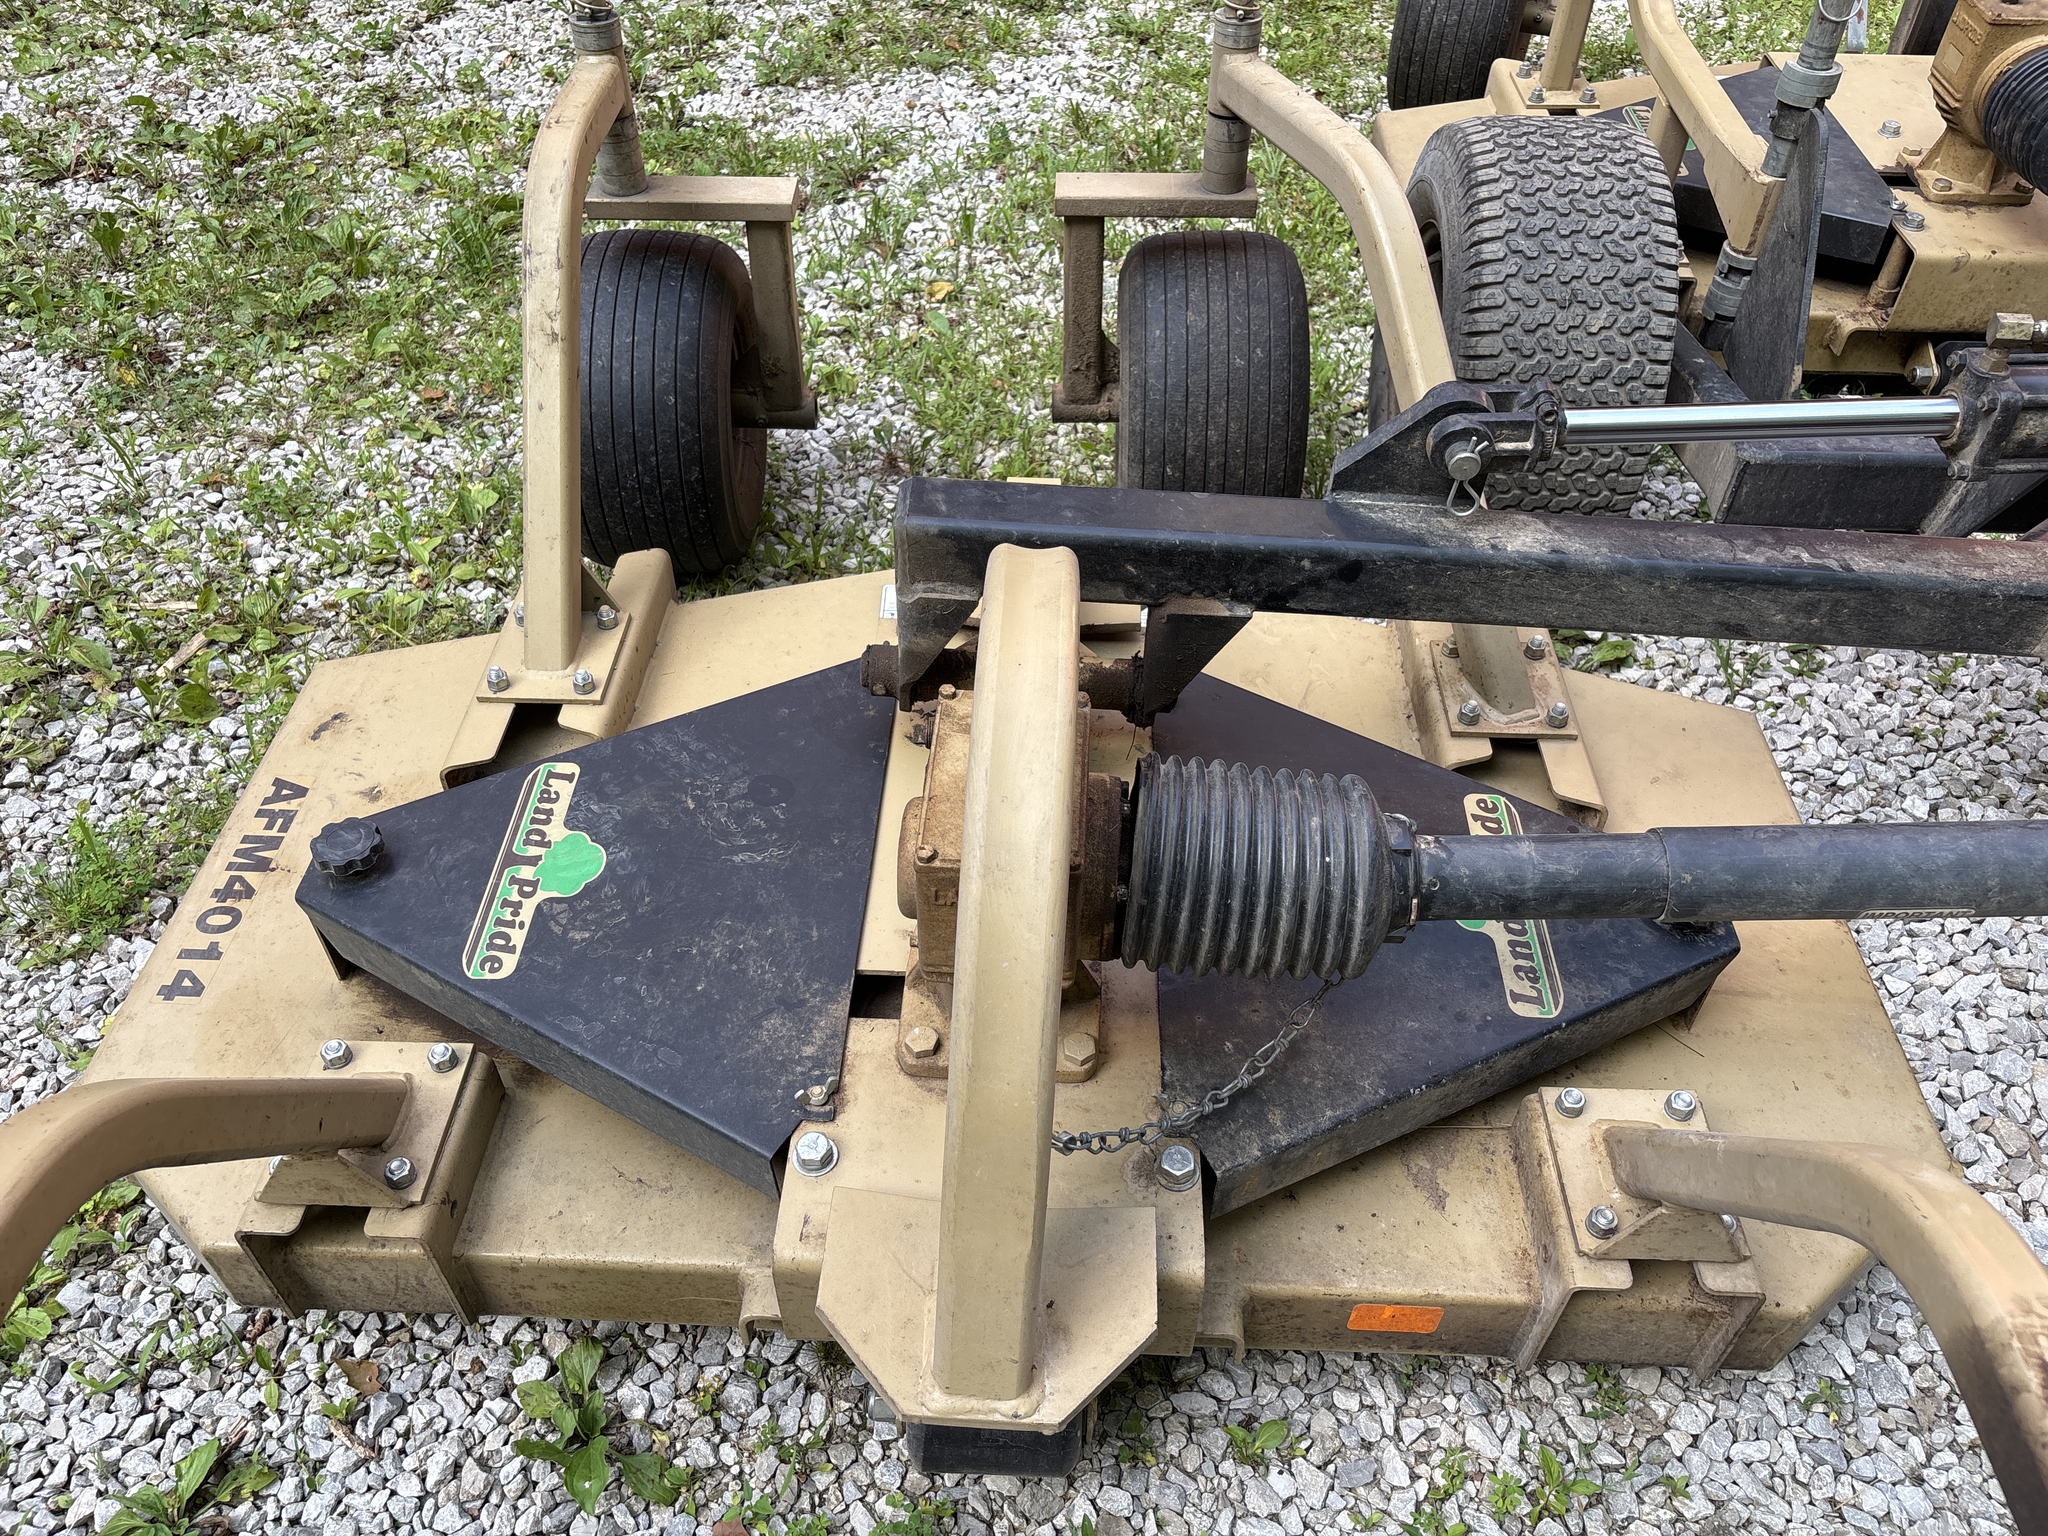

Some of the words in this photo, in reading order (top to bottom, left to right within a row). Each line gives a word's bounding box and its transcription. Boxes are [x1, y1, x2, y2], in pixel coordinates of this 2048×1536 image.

[523, 769, 576, 849] Land
[156, 777, 310, 1001] AFM4014
[480, 875, 541, 974] Pride
